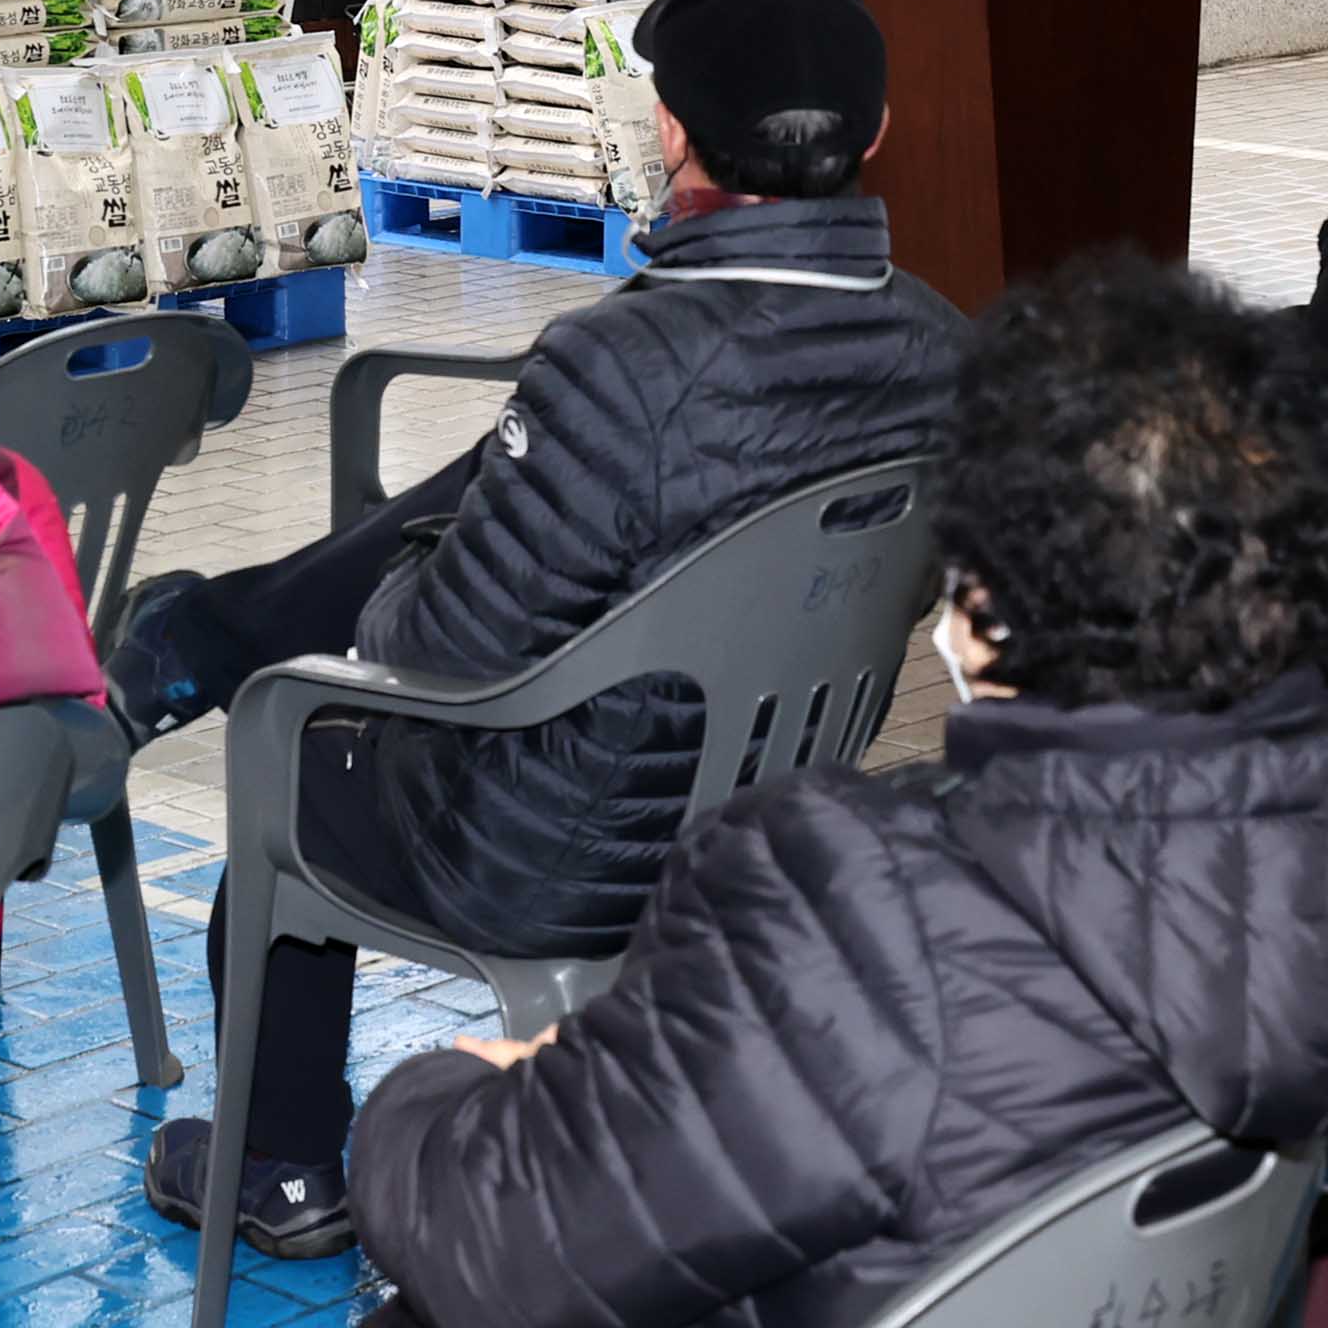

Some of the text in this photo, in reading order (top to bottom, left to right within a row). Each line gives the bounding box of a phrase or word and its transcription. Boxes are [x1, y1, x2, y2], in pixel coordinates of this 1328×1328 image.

[311, 117, 343, 139] 강화
[201, 136, 226, 156] 강화
[327, 163, 353, 193] 쌀
[215, 178, 241, 209] 쌀
[102, 198, 127, 228] 쌀
